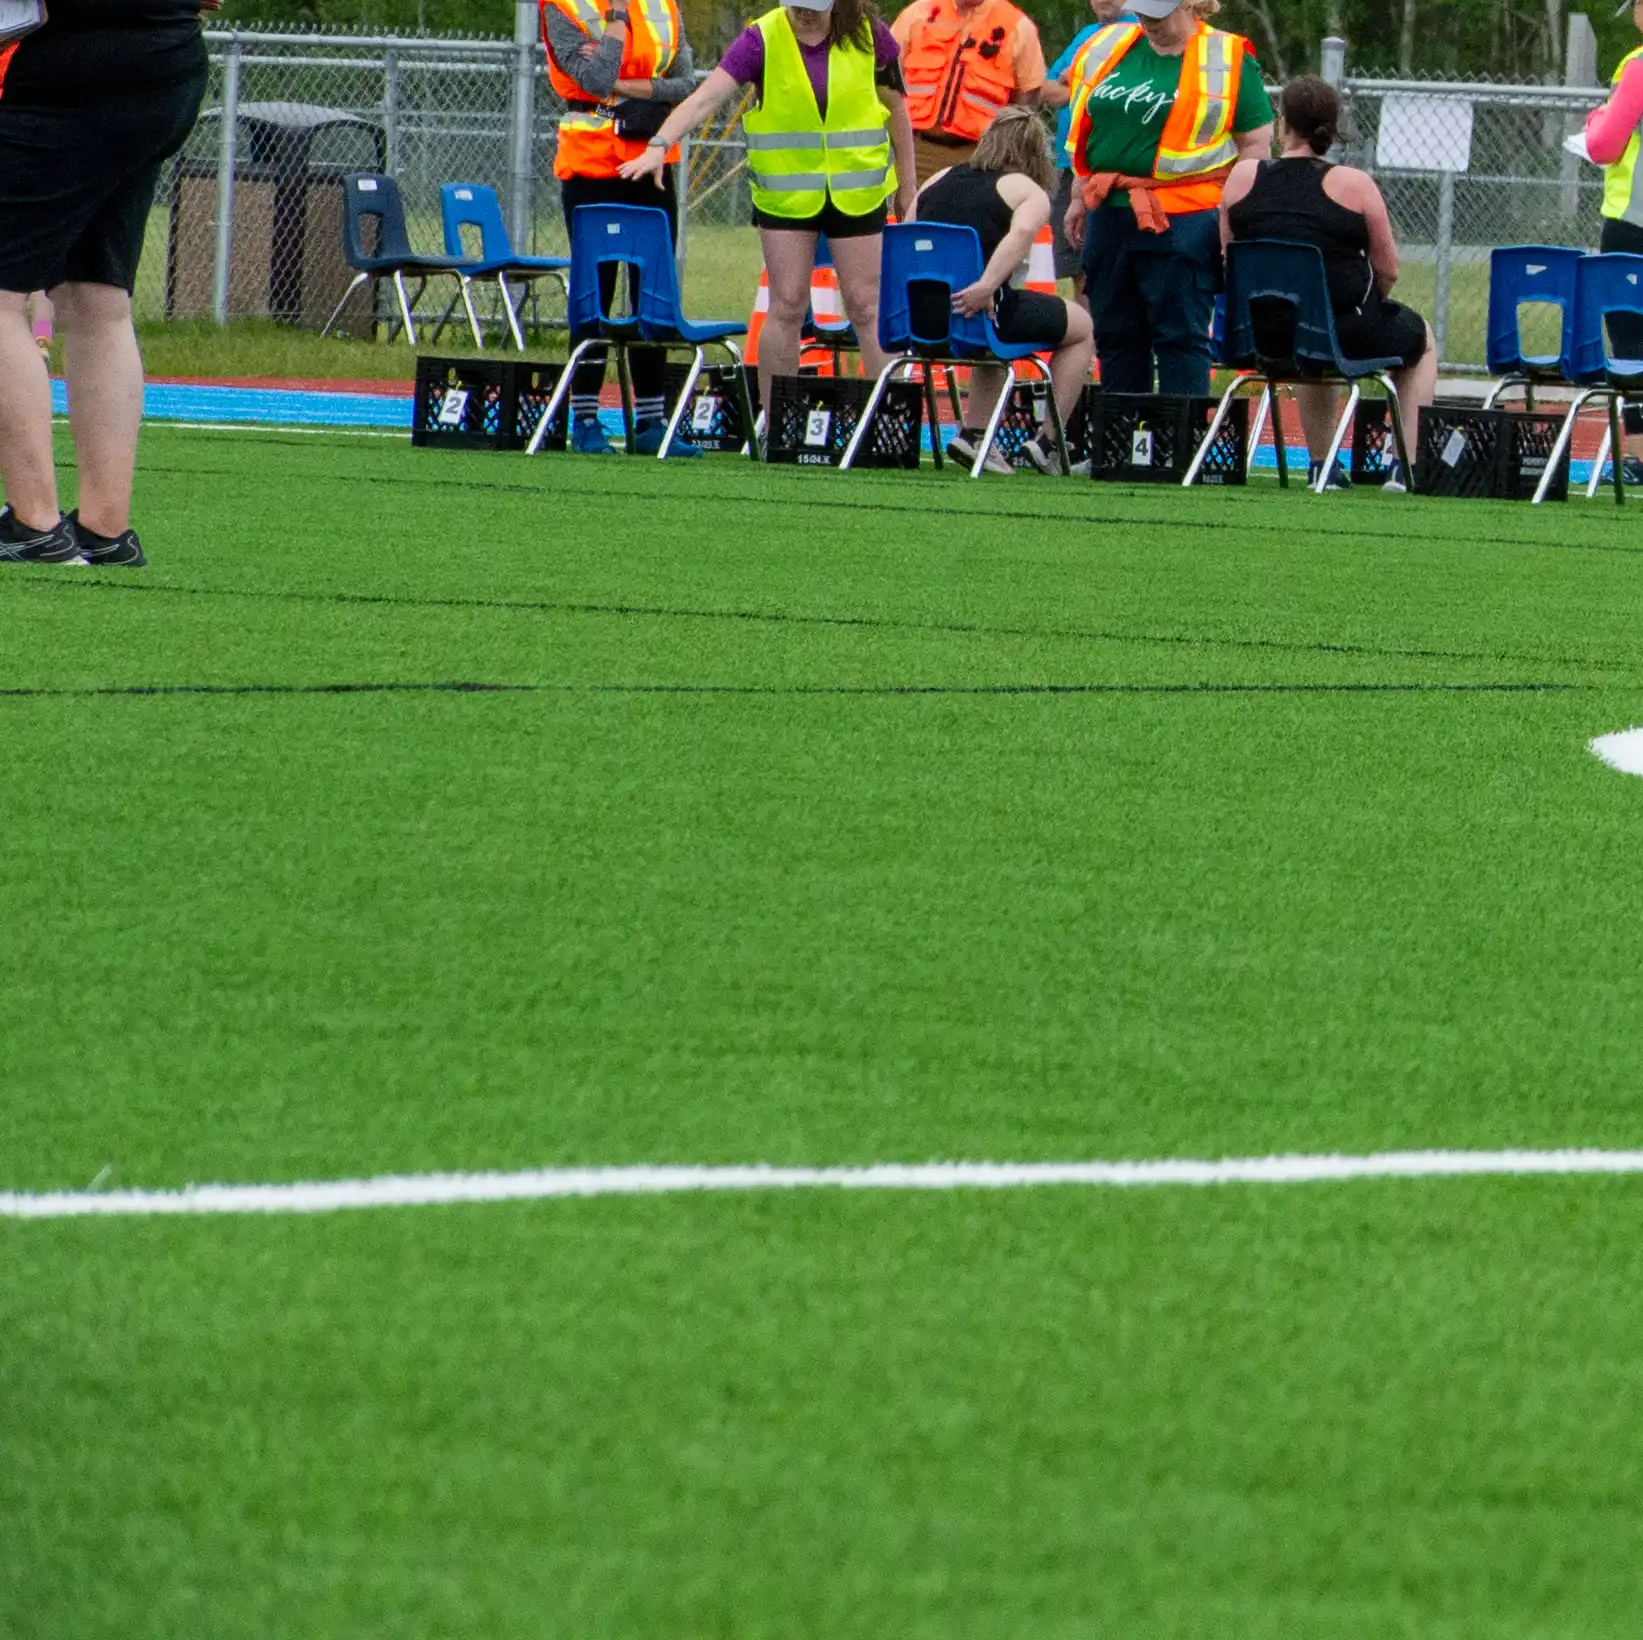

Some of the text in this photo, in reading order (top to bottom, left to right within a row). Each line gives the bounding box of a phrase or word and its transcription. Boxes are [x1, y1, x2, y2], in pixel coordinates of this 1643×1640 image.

[445, 396, 461, 414] 2
[696, 402, 710, 420] 2
[809, 418, 825, 436] 3
[1134, 437, 1149, 457] 4
